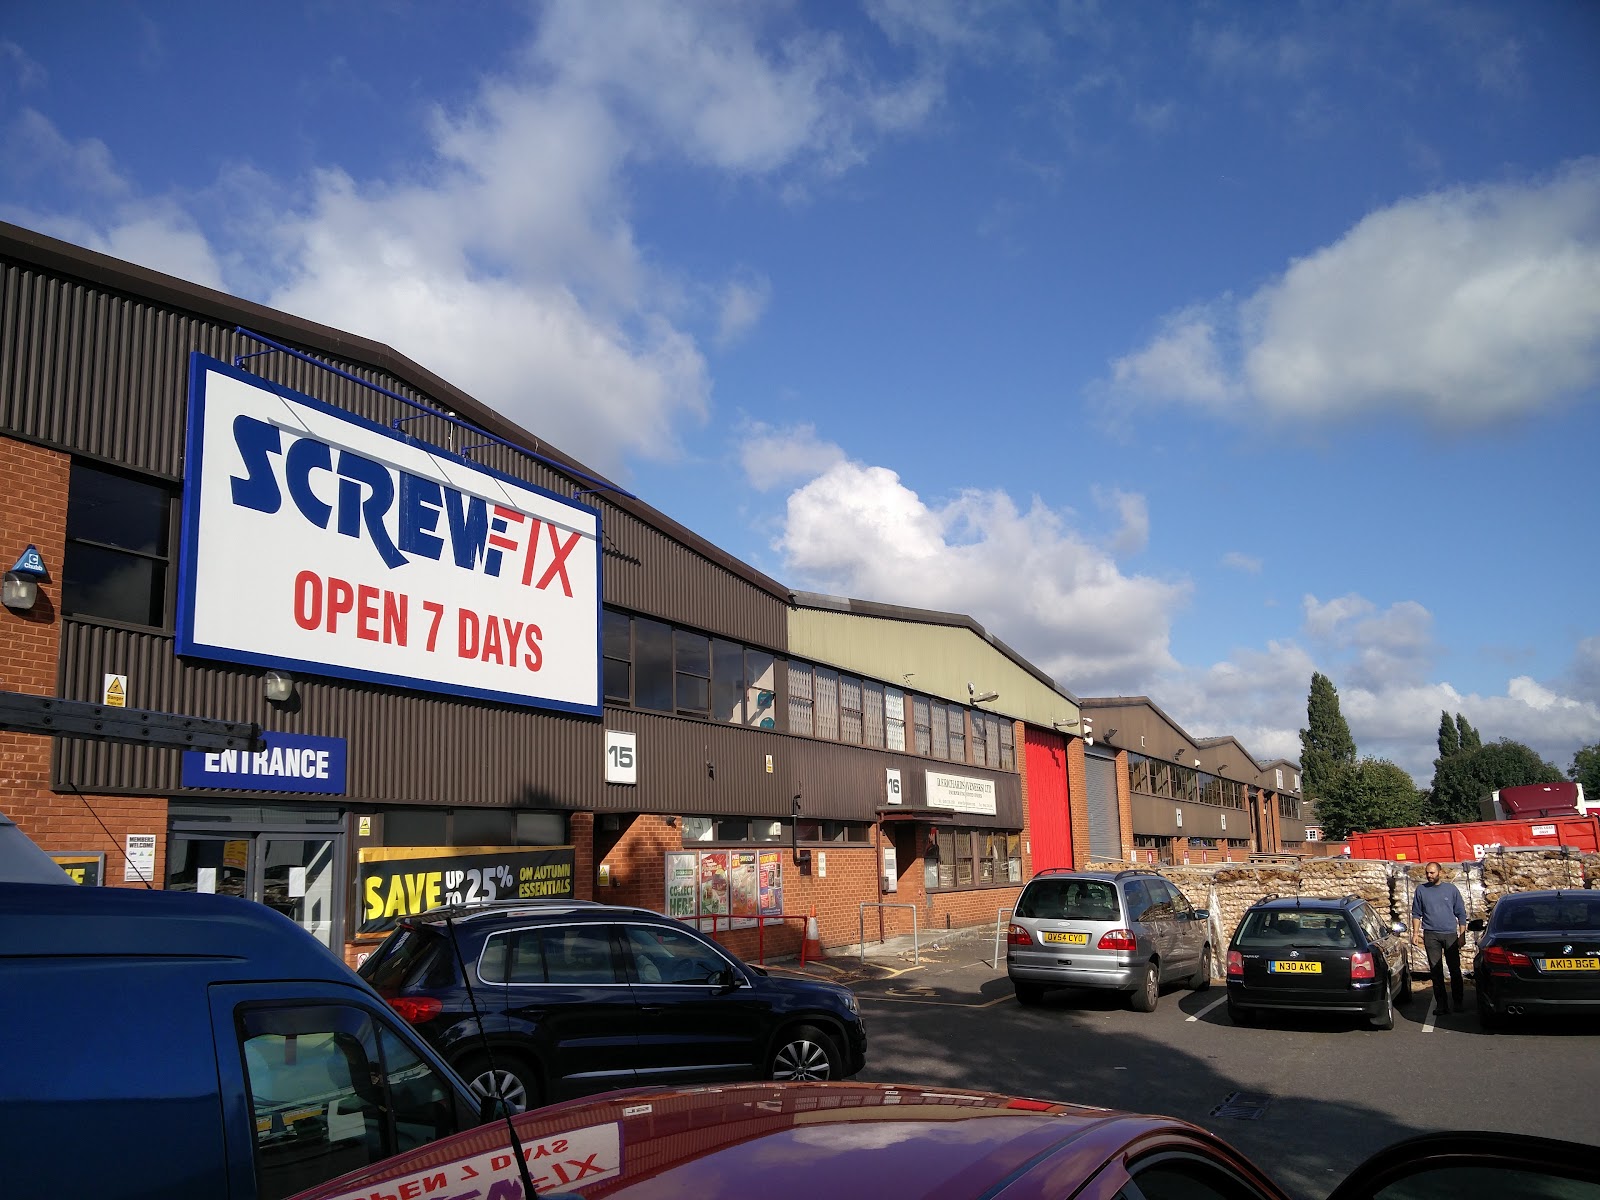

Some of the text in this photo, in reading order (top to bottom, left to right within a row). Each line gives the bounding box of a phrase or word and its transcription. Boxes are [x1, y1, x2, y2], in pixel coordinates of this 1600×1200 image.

[230, 414, 583, 598] SCREWFIX
[294, 570, 542, 672] OPEN 7 DAYS
[204, 747, 329, 779] ENTRANCE
[608, 745, 633, 768] 15
[889, 778, 900, 794] 16
[519, 863, 571, 881] ON AUTUMN
[365, 865, 514, 919] SAVE UP 25%
[518, 879, 571, 898] ESSENTIALS
[670, 885, 693, 897] COLLECT
[445, 891, 462, 906] TO
[670, 897, 694, 916] HERE
[1299, 963, 1316, 971] AKC
[1550, 959, 1595, 968] AK13 BGE
